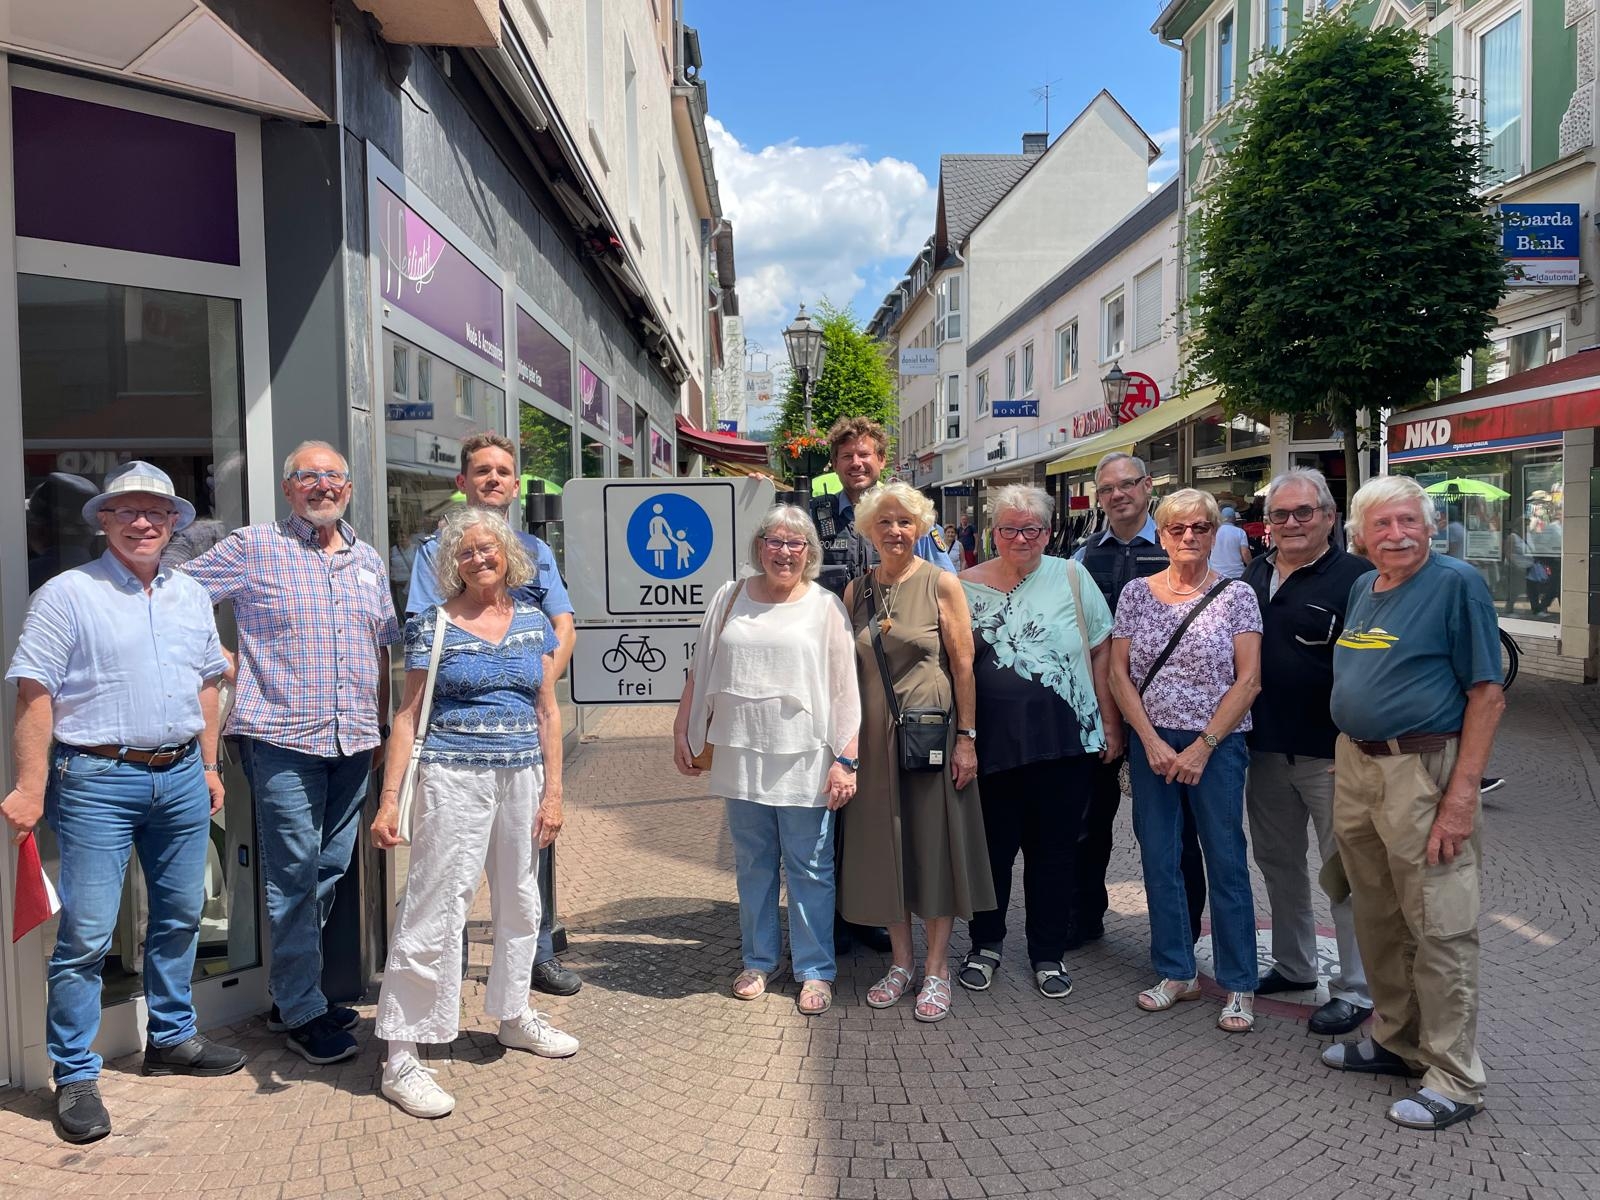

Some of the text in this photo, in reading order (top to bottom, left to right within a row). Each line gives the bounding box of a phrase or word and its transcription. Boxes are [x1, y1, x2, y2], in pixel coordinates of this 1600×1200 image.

[1516, 236, 1565, 250] Bank
[994, 402, 1036, 415] BONITA
[717, 422, 731, 432] sky
[1404, 419, 1451, 450] NKD
[640, 584, 703, 605] ZONE
[618, 678, 652, 696] frei
